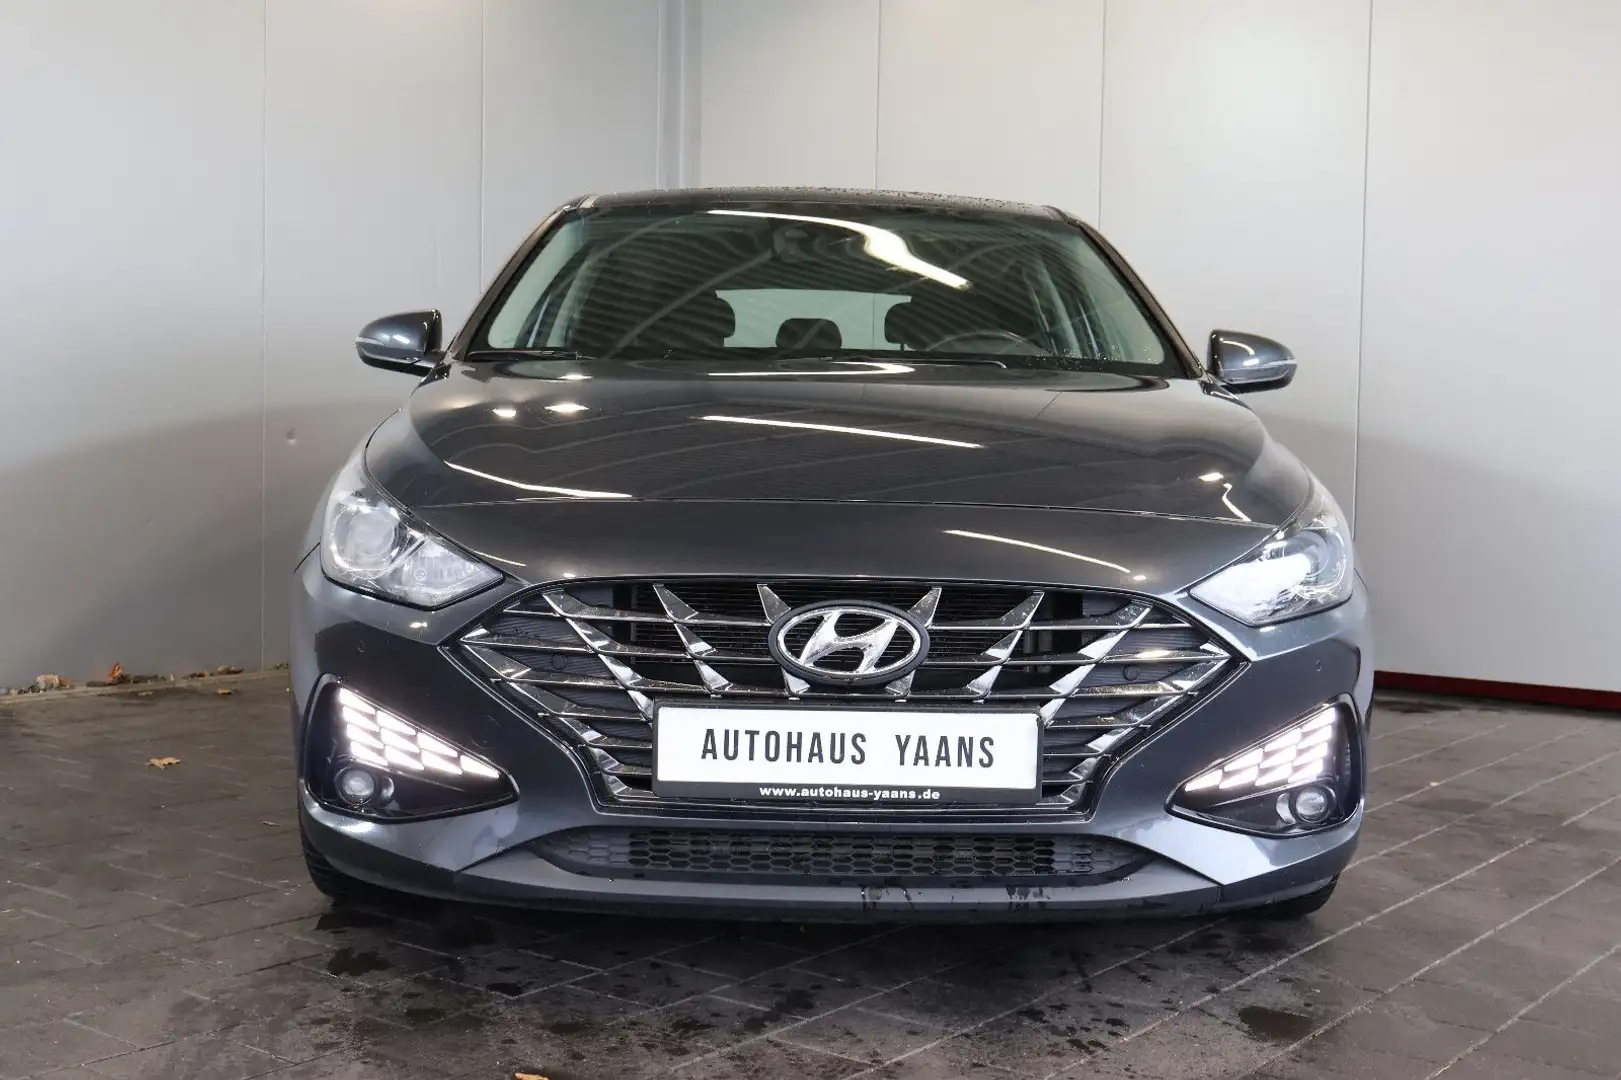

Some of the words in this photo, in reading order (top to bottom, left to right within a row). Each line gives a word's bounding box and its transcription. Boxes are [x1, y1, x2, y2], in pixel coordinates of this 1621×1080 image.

[701, 728, 867, 764] AUTOHAUS
[895, 734, 994, 768] YAANS
[758, 786, 940, 801] www.autohaus-yaans.de
